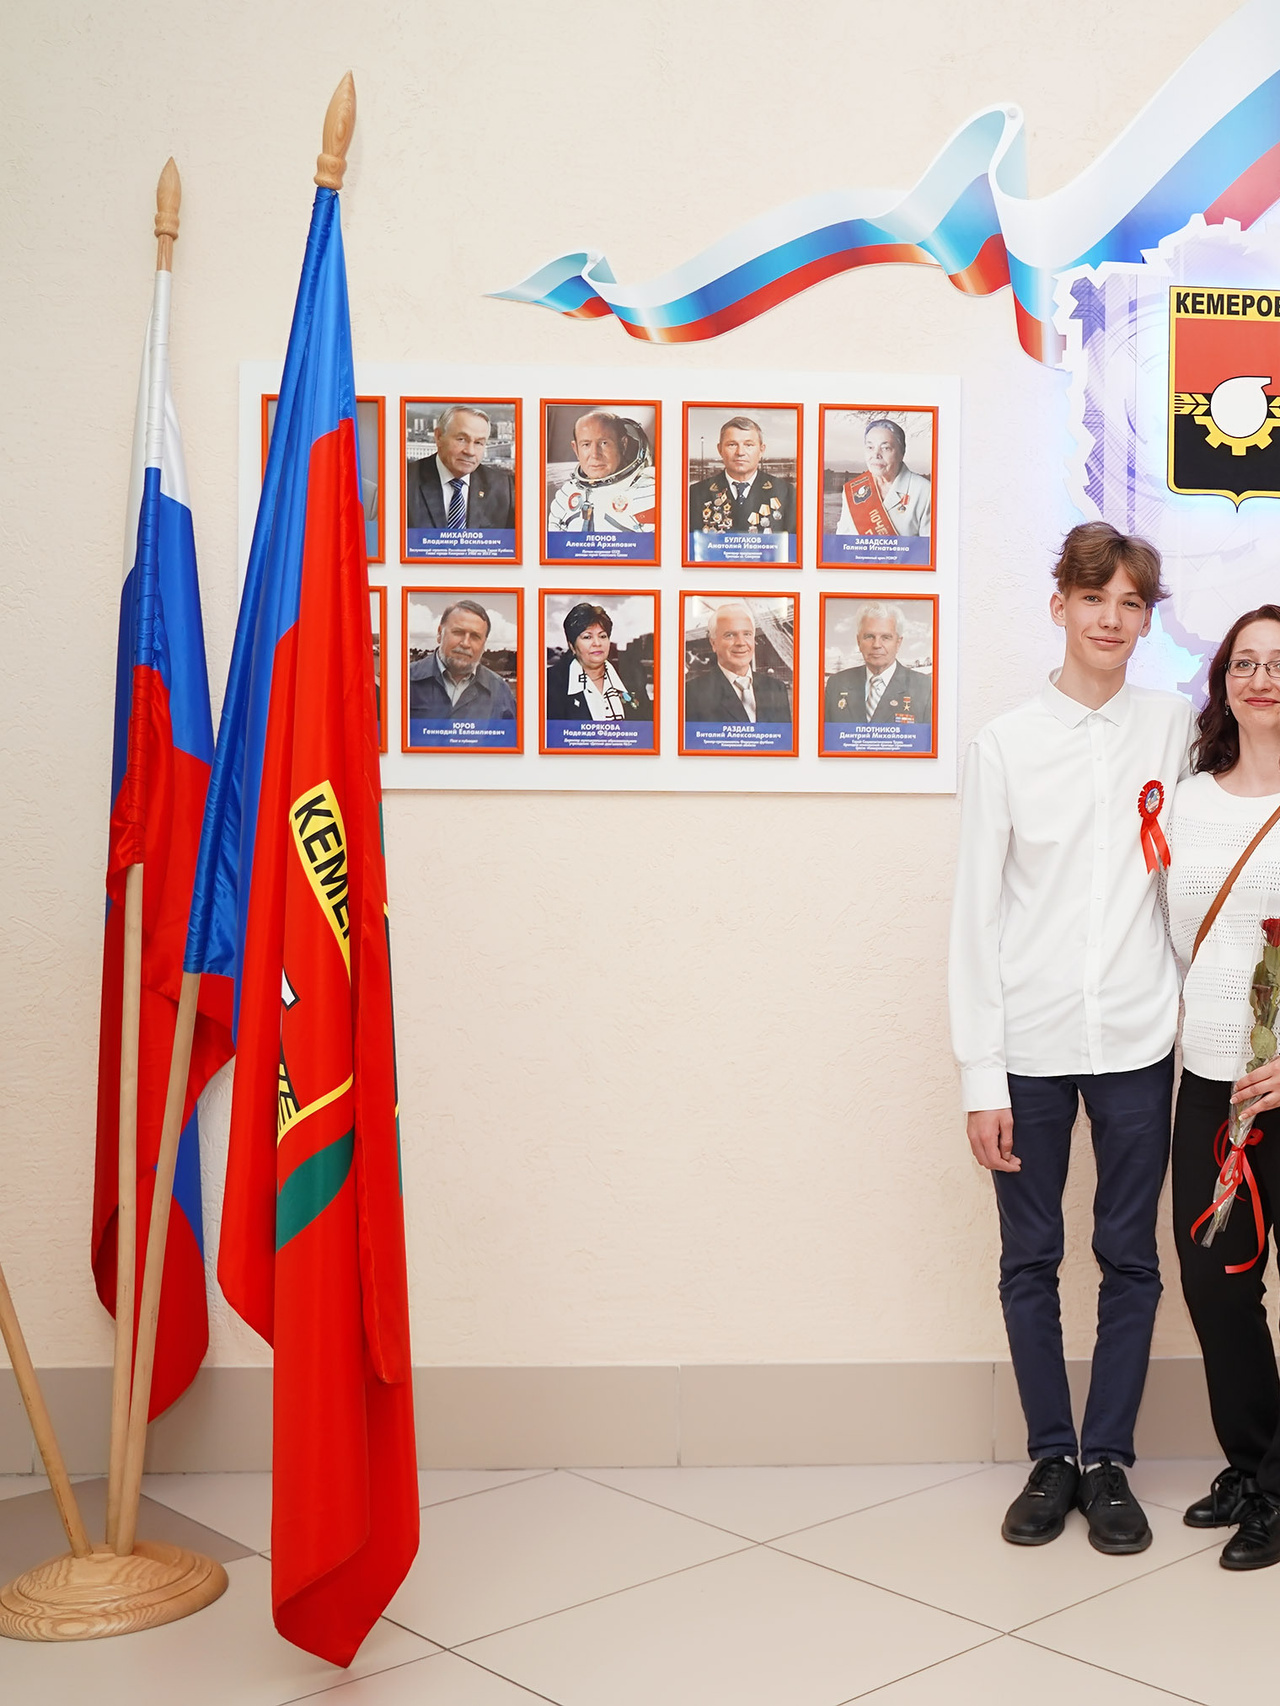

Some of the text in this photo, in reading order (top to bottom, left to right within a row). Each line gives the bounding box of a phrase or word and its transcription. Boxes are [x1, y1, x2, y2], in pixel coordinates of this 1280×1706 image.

[423, 538, 458, 546] Владимир
[597, 541, 637, 549] Архипович
[855, 538, 898, 546] ЗАВАДСКАЯ
[597, 730, 638, 738] Фёдоровна
[294, 793, 350, 940] КЕМЕ
